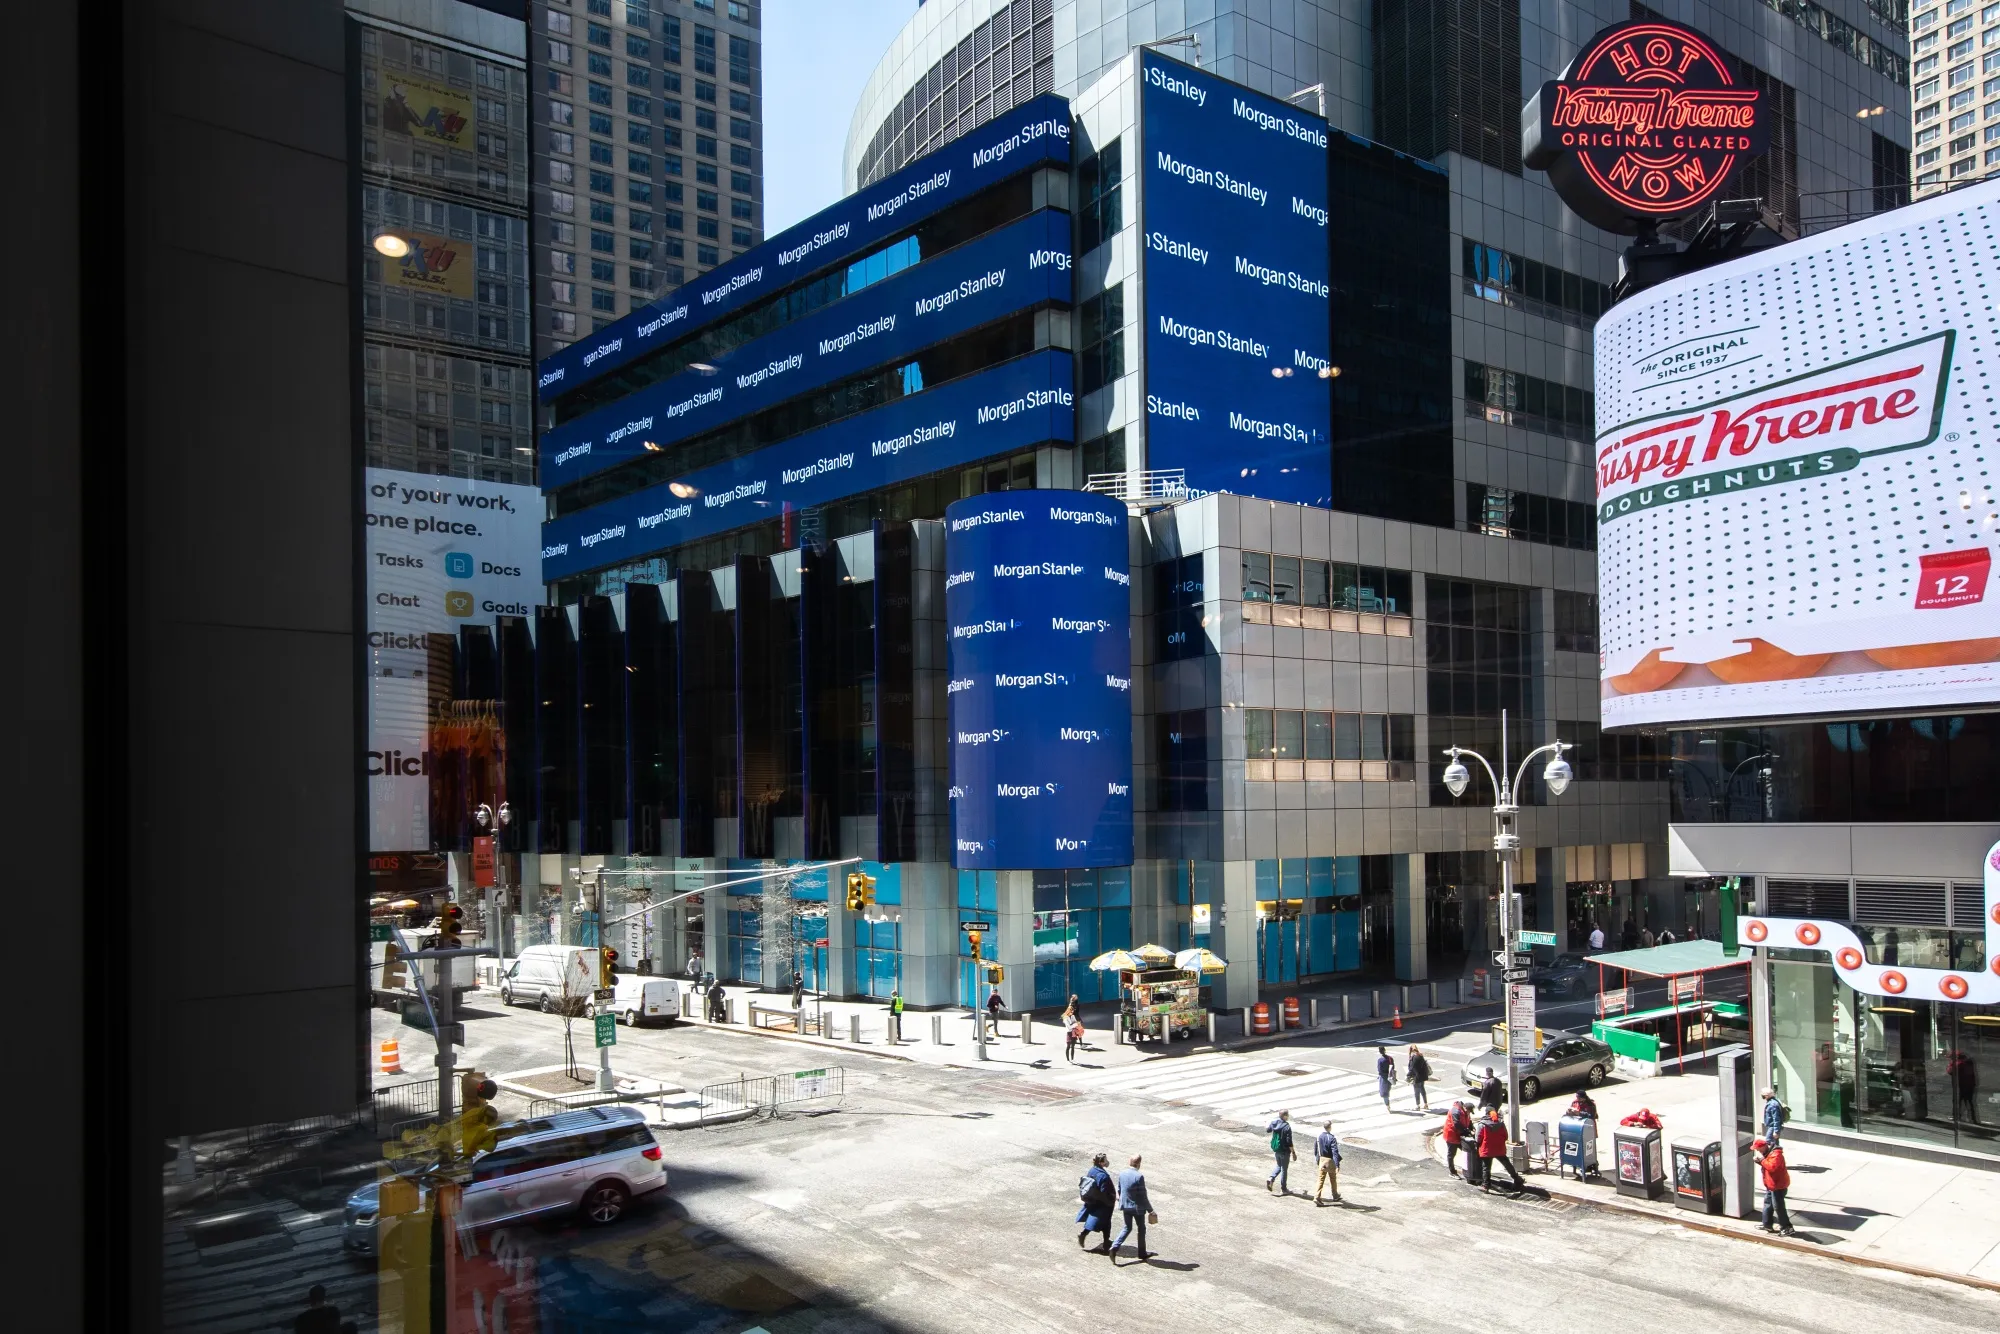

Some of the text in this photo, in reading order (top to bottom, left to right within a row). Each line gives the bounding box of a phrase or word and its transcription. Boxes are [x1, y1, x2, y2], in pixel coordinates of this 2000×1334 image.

[1610, 37, 1701, 76] HOT
[1151, 66, 1207, 106] Stanley
[1234, 97, 1284, 132] Morgan
[1551, 86, 1759, 134] Krispy Kreme
[974, 135, 1019, 168] Morgan
[1561, 133, 1752, 150] ORIGINAL GLAZED
[1159, 152, 1267, 206] Morgan Stanley
[1609, 156, 1706, 198] NOW
[868, 170, 951, 222] Morgan Stanley
[779, 222, 849, 265] Morgan Stanley
[732, 267, 762, 290] Stanley
[1236, 256, 1285, 286] Morgan
[916, 269, 1005, 316] Morgan Stanley
[661, 305, 688, 326] Stanley
[820, 315, 895, 355] Morgan Stanley
[1161, 316, 1214, 345] Morgan
[598, 338, 622, 357] Stanley
[1640, 337, 1749, 375] the ORIGINAL
[769, 354, 802, 376] Stanley
[1657, 353, 1729, 380] SINCE 1937
[694, 387, 722, 407] Stanley
[978, 399, 1024, 424] Morgan
[1702, 364, 1924, 463] Kreme
[627, 417, 653, 434] Stanley
[873, 420, 955, 456] Morgan Stanley
[1230, 412, 1281, 438] Morgan
[783, 453, 854, 484] Morgan Stanley
[371, 482, 516, 514] of your work,
[705, 480, 766, 507] Morgan Stanley
[1605, 454, 1835, 519] DOUGHNUTS
[365, 513, 482, 536] one place.
[664, 504, 691, 520] Stanley
[953, 516, 981, 532] Morgan
[1051, 508, 1094, 524] Morgan
[602, 525, 625, 540] Stanley
[376, 553, 521, 577] Tasks Docs
[995, 565, 1040, 578] Morgan
[1934, 575, 1971, 596] 12
[376, 593, 528, 615] Chat Goals
[1920, 593, 1980, 606] DOUGHNUTS
[954, 625, 983, 638] Morgan
[996, 674, 1041, 688] Morgan
[1523, 933, 1554, 943] BROADWAY
